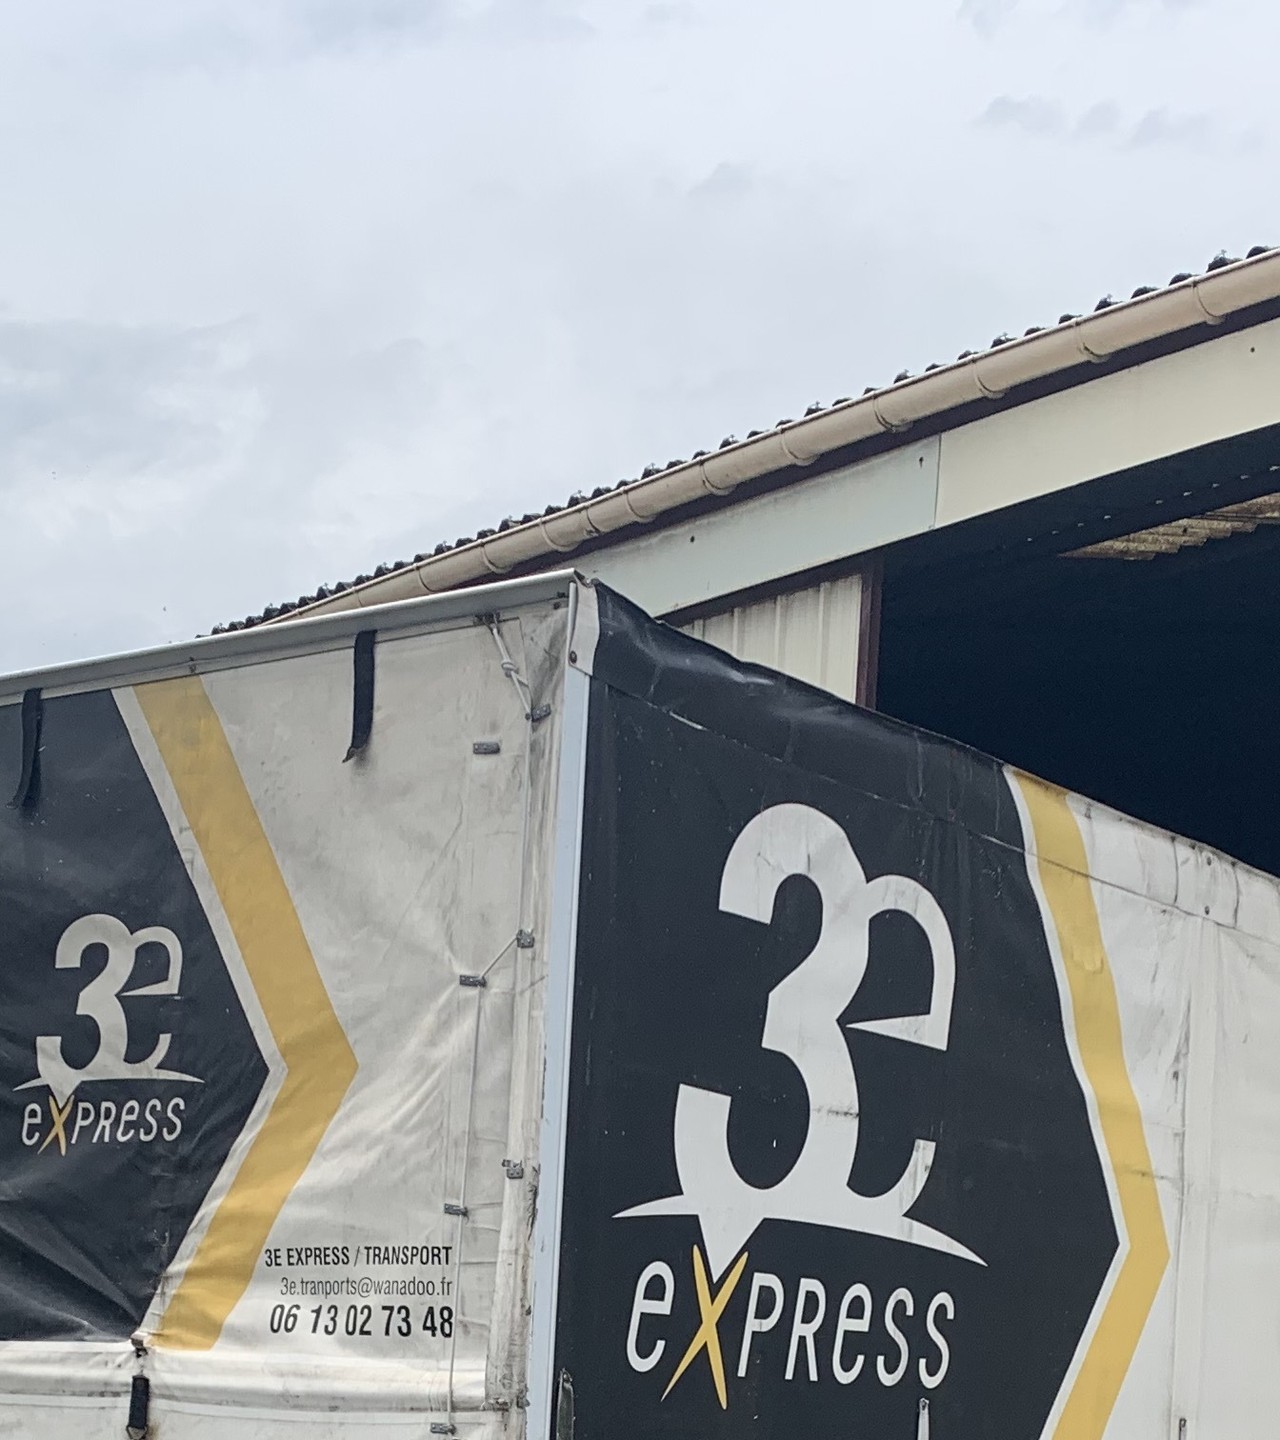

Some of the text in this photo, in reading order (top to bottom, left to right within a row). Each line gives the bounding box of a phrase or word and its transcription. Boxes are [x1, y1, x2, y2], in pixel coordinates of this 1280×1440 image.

[265, 1246, 453, 1267] 3E EXPRESS / TRANSPORT
[280, 1276, 453, 1299] 3e.tranports@wanadoo.fr
[270, 1304, 454, 1338] 06 13 02 73 48
